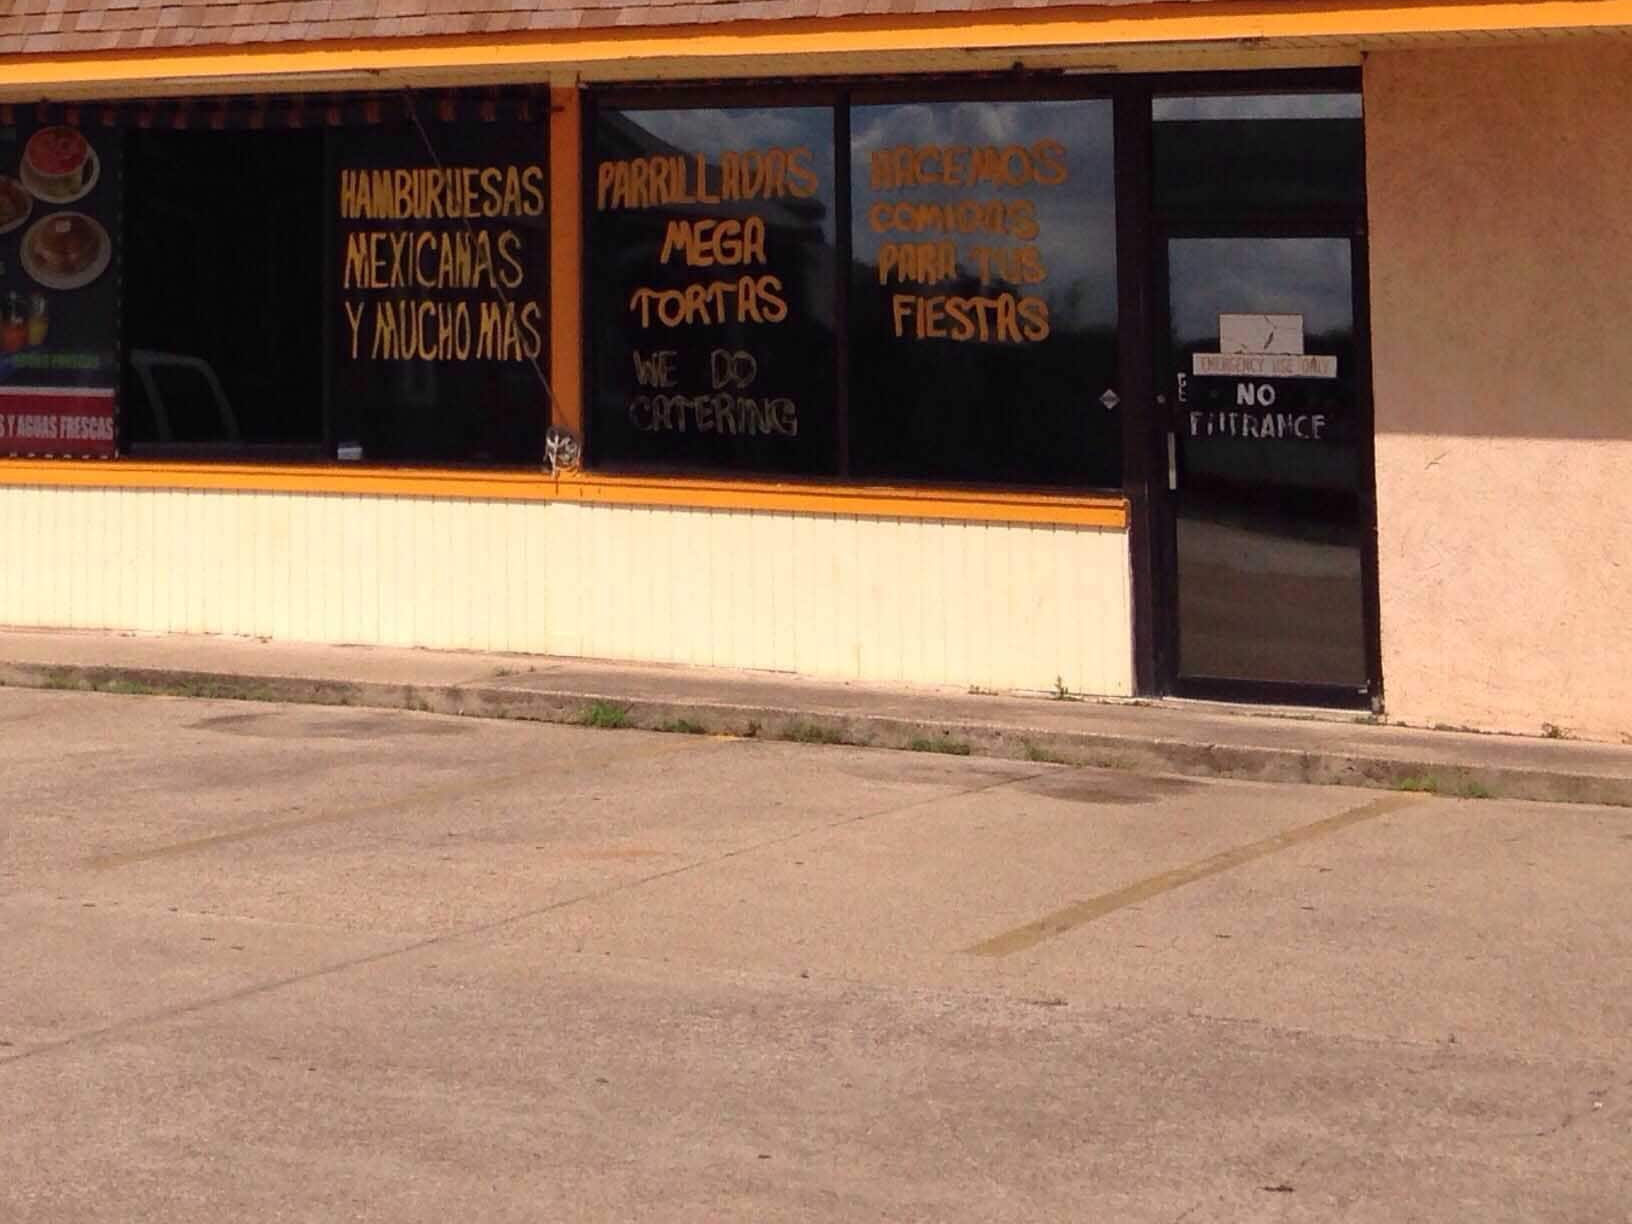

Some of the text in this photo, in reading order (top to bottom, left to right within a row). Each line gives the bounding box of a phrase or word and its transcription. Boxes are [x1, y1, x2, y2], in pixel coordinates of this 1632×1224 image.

[597, 147, 818, 211] PARRILLADAS
[870, 138, 1068, 191] HACEMOS
[659, 215, 768, 267] MEGA
[868, 199, 1041, 240] COMIDAS
[344, 228, 524, 289] MEXICANAS
[879, 240, 1047, 287] PARA TUS
[630, 274, 789, 328] TORTAS
[892, 291, 1050, 343] FIESTAS
[344, 300, 542, 362] Y MUCHO MAS
[632, 347, 759, 390] WE DO
[1236, 382, 1277, 406] NO
[628, 391, 800, 437] CATERING
